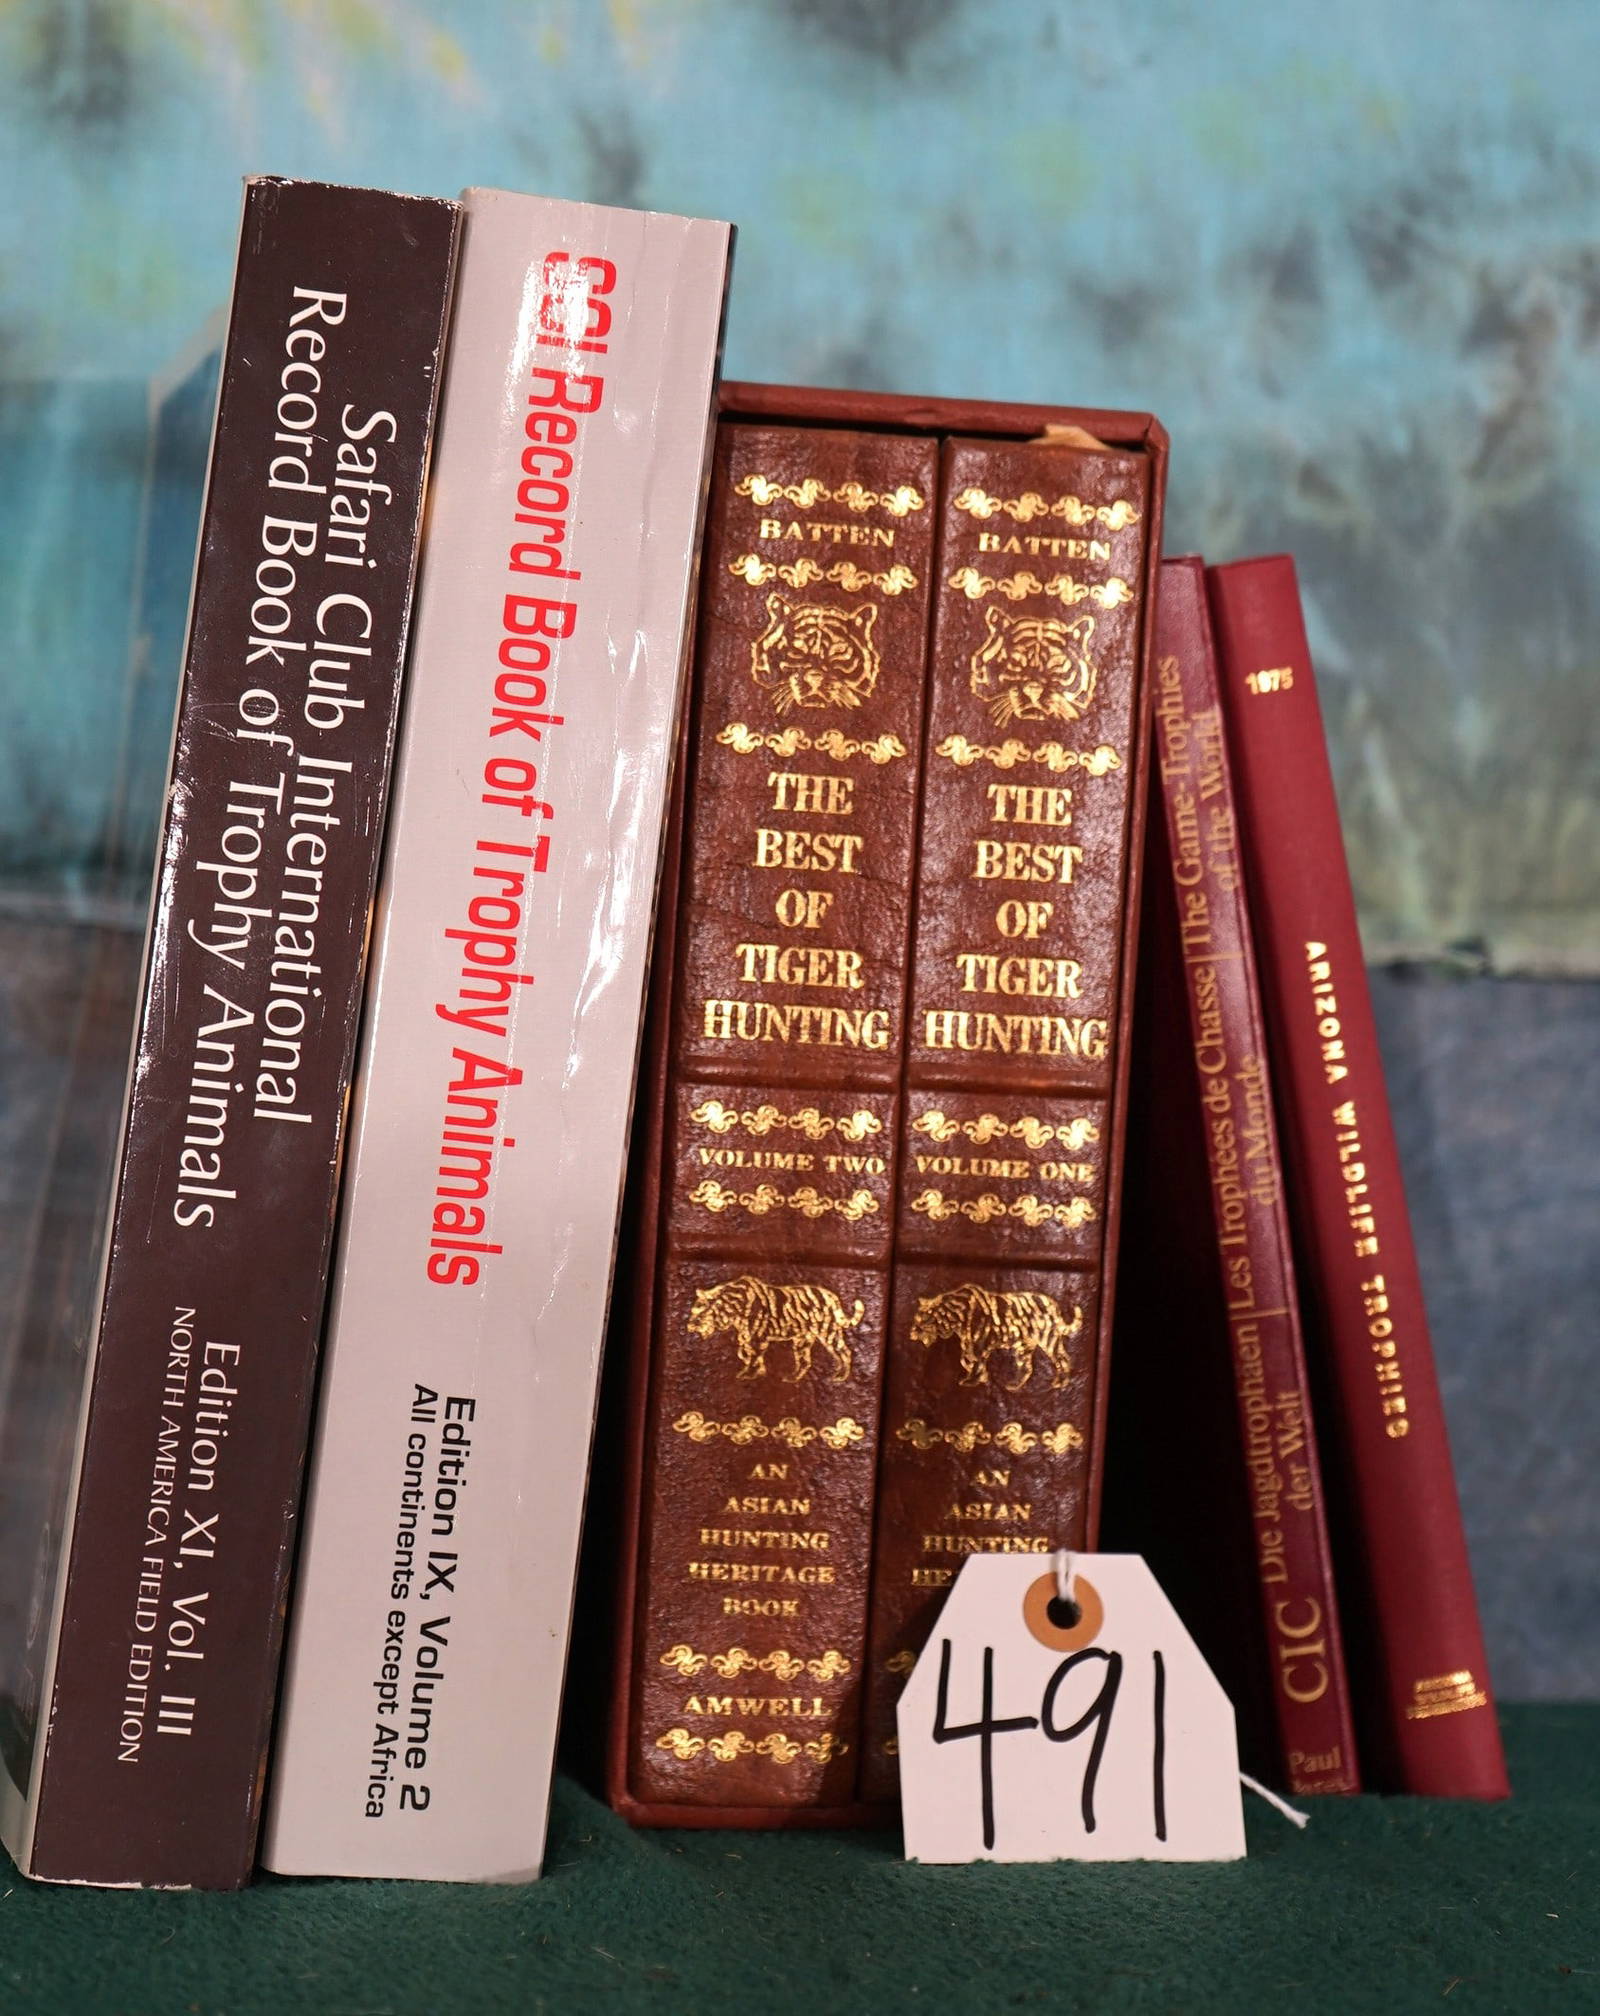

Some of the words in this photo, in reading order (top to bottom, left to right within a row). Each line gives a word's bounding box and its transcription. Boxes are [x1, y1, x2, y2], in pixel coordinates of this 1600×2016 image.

[267, 286, 348, 495] Record
[324, 403, 398, 569] Safari
[509, 367, 605, 581] Record
[759, 518, 895, 548] BATTEN
[978, 532, 1111, 561] BATTEN
[245, 514, 318, 666] Book
[304, 593, 373, 729] Club
[489, 594, 577, 742] Book
[236, 688, 294, 757] of
[481, 757, 554, 820] of
[768, 772, 854, 815] THE
[988, 783, 1073, 826] THE
[187, 772, 286, 970] Trophy
[752, 828, 863, 874] BEST
[972, 840, 1083, 884] BEST
[435, 835, 550, 1037] Trophy
[775, 889, 833, 929] OF
[995, 900, 1053, 939] OF
[1181, 890, 1212, 949] The
[254, 754, 353, 1124] International
[736, 943, 864, 989] TIGER
[956, 953, 1084, 999] TIGER
[703, 999, 890, 1051] HUNTING
[922, 1009, 1108, 1058] HUNTING
[1195, 964, 1227, 1074] Chasse
[174, 983, 254, 1229] Animals
[1202, 1078, 1231, 1113] de
[427, 1047, 523, 1286] Animals
[699, 1147, 815, 1171] VOLUME
[824, 1156, 886, 1175] TWO
[913, 1155, 1029, 1180] VOLUME
[1040, 1162, 1095, 1183] ONE
[1305, 941, 1348, 1085] ARIZONA
[1332, 1100, 1380, 1258] WILDLIFE
[1361, 1274, 1409, 1439] TROPHIES
[1230, 1260, 1255, 1309] Les
[163, 1306, 196, 1406] NORTH
[188, 1341, 241, 1493] Edition
[411, 1383, 439, 1423] All
[145, 1416, 183, 1547] AMERICA
[431, 1396, 476, 1537] Edition
[748, 1463, 788, 1480] AN
[973, 1470, 1010, 1488] AN
[391, 1432, 427, 1600] continents
[724, 1496, 811, 1516] ASIAN
[944, 1503, 1032, 1521] ASIAN
[173, 1509, 220, 1569] XI,
[700, 1529, 830, 1550] HUNTING
[922, 1535, 1049, 1554] HUNTING
[135, 1556, 164, 1633] FIELD
[420, 1552, 458, 1600] IX,
[688, 1562, 836, 1585] HERITAGE
[164, 1591, 209, 1672] Vol.
[722, 1597, 801, 1618] BOOK
[373, 1610, 406, 1715] except
[1275, 1595, 1329, 1703] CIC
[118, 1643, 153, 1763] EDITION
[157, 1695, 196, 1736] III
[405, 1616, 451, 1770] Volume
[684, 1696, 833, 1717] AMWELL
[365, 1724, 399, 1818] Africa
[933, 1638, 1167, 1850] 491
[400, 1784, 430, 1810] 2
